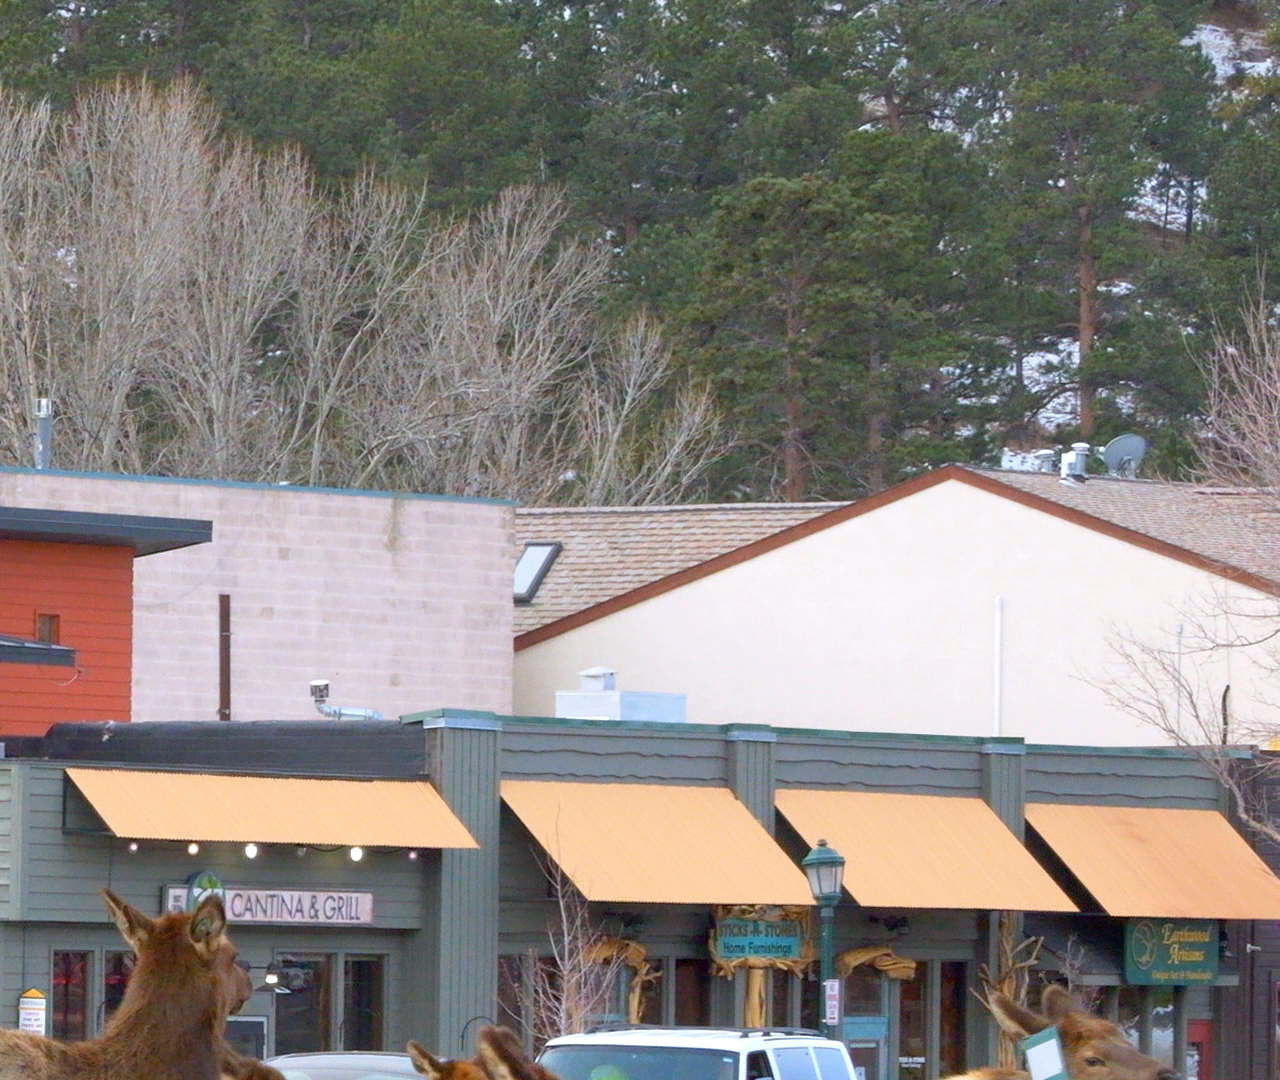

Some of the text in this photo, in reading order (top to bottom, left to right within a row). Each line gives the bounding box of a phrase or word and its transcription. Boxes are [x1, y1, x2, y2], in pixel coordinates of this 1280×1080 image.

[231, 892, 361, 921] CANTINA & GRILL
[723, 941, 792, 957] Home Furnishings
